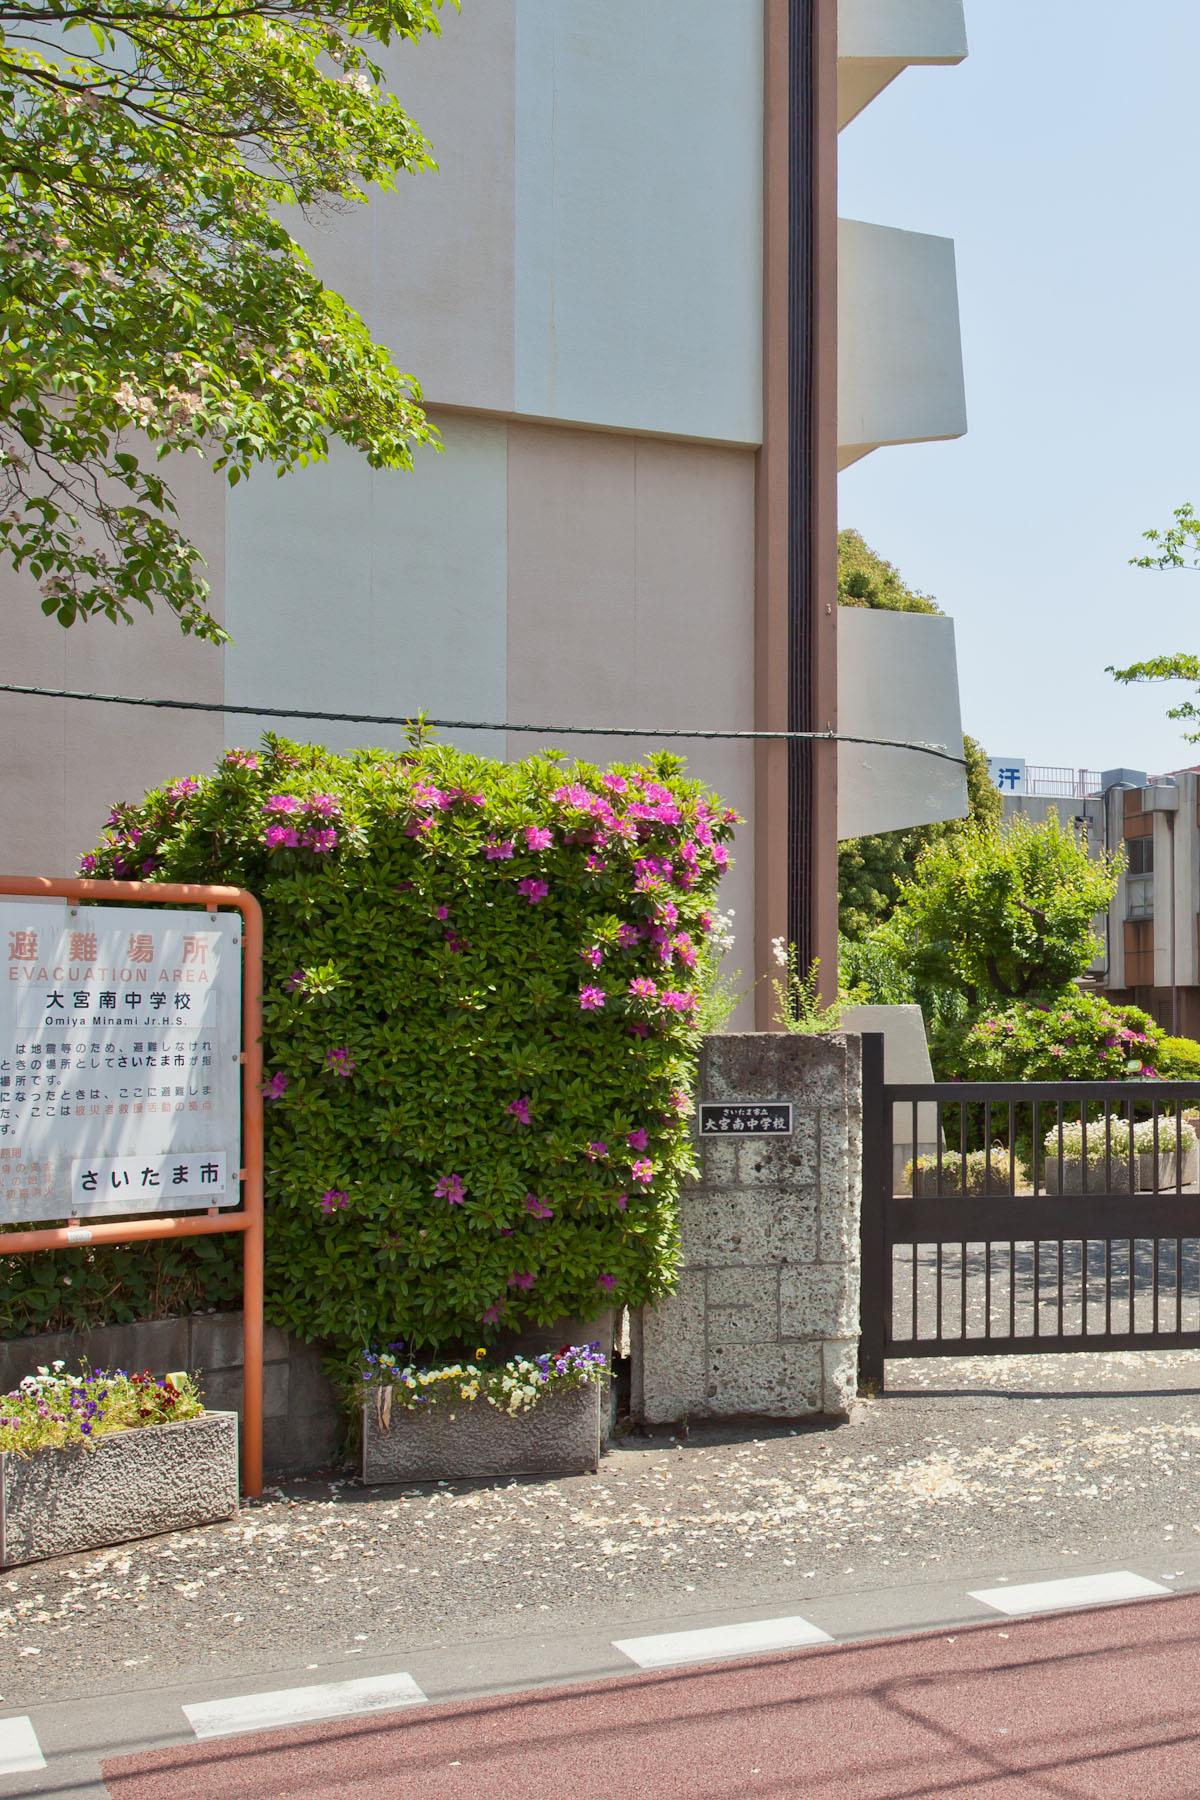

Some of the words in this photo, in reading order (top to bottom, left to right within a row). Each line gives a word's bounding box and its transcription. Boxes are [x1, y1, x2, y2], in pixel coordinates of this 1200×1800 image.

[998, 768, 1021, 789] 汗
[8, 931, 208, 964] 避難場所
[9, 966, 147, 982] EVACUATION
[158, 968, 209, 983] AREA
[46, 990, 191, 1010] 大宮南中学校
[45, 1016, 86, 1027] Omiya
[92, 1016, 138, 1026] Minami
[723, 1108, 769, 1116] さいたま市立
[704, 1116, 787, 1131] 大宮南中学校
[81, 1163, 219, 1191] さいたま市
